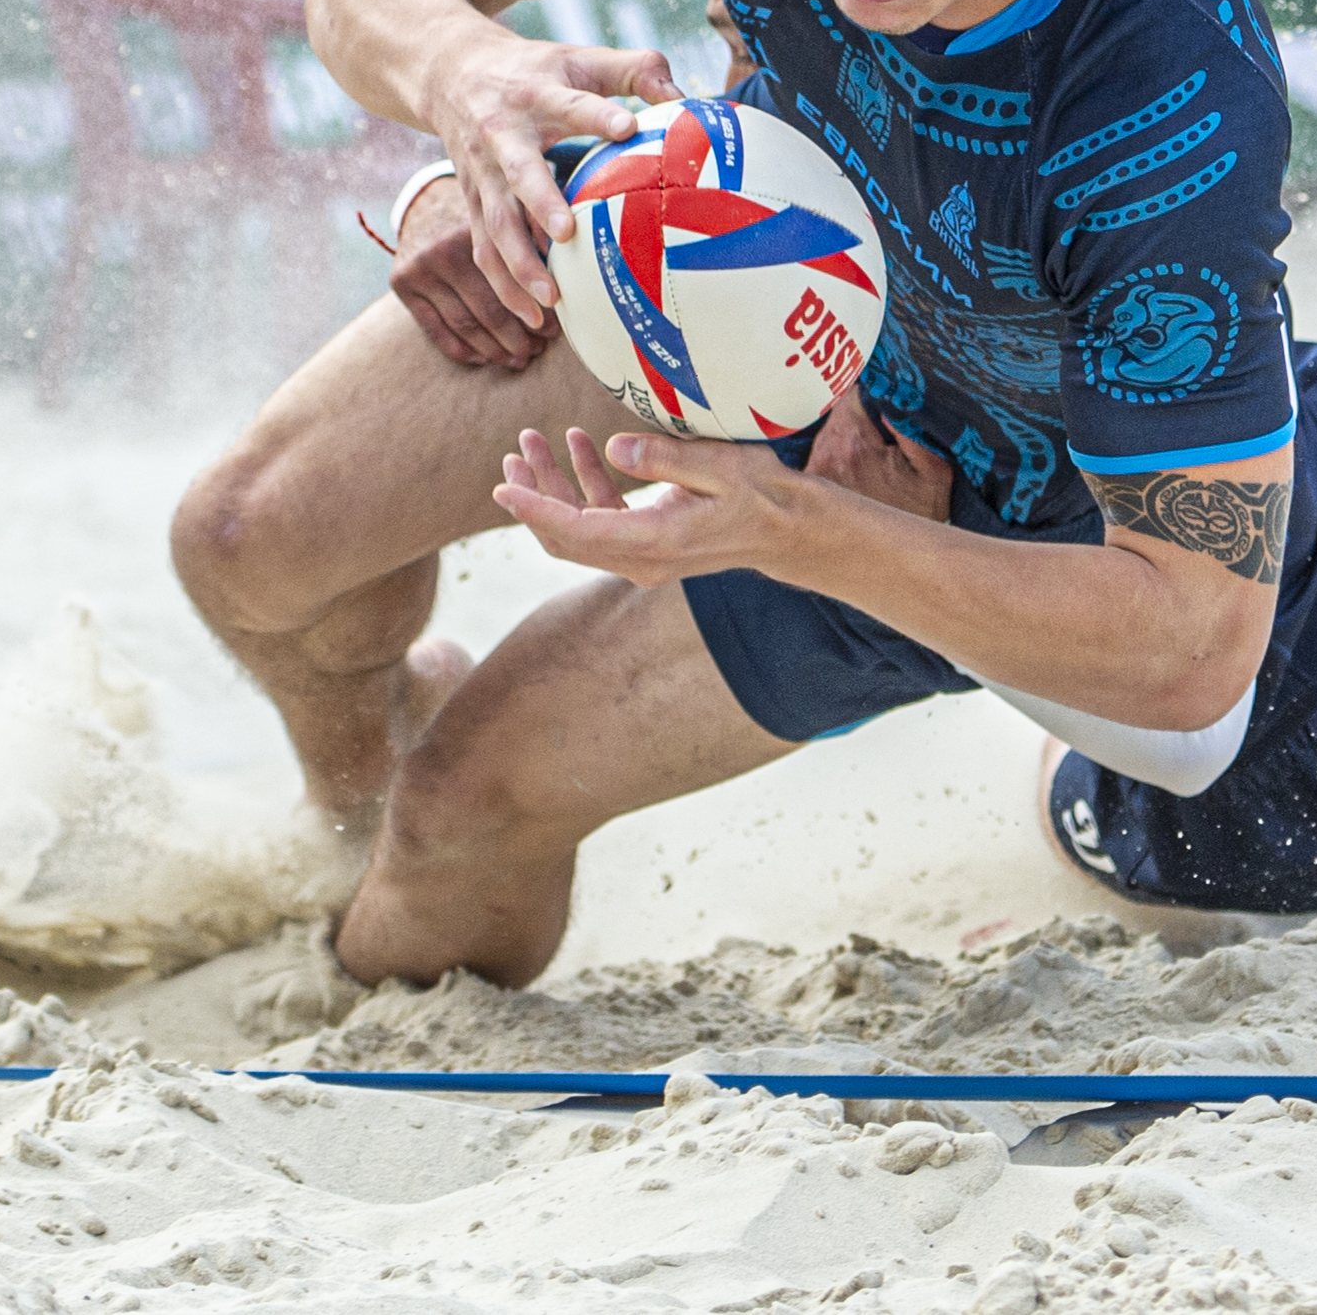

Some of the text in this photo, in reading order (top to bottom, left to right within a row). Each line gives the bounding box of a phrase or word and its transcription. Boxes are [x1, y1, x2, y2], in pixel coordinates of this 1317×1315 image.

[796, 92, 973, 309] ЕВРОХИМ
[605, 267, 629, 305] AGES
[647, 338, 681, 369] SIZE
[784, 286, 865, 411] ussia
